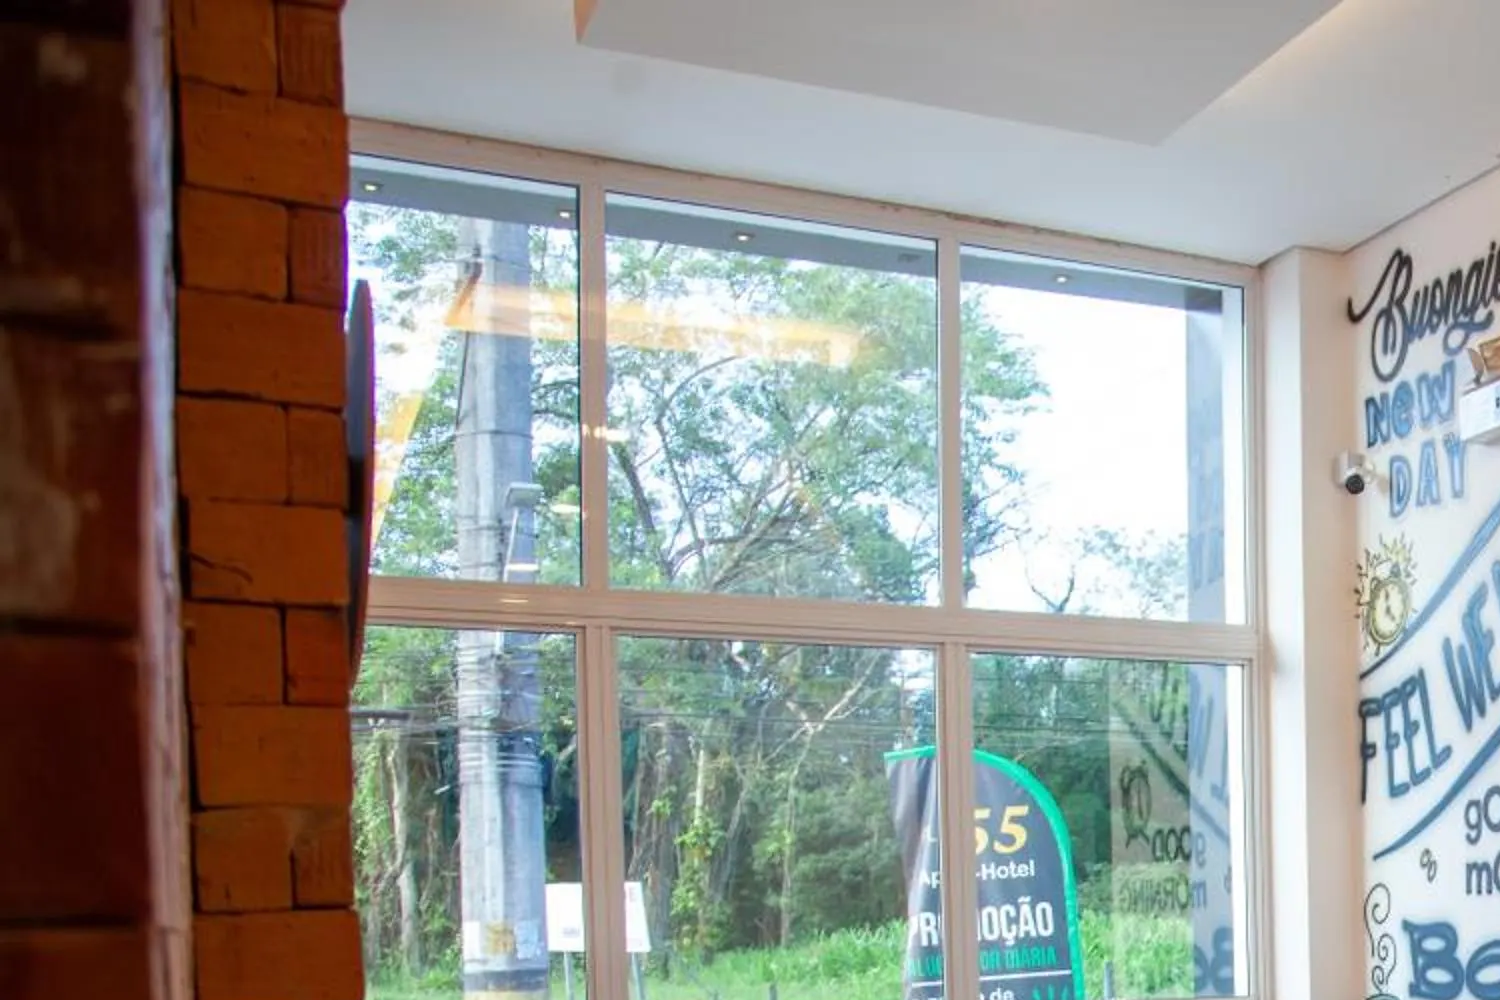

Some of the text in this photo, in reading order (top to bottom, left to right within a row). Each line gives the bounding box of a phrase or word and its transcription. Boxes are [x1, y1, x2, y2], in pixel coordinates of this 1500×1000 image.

[1388, 431, 1468, 518] DAY
[1358, 667, 1454, 806] FEEL
[907, 896, 1054, 948] PROÇÃO
